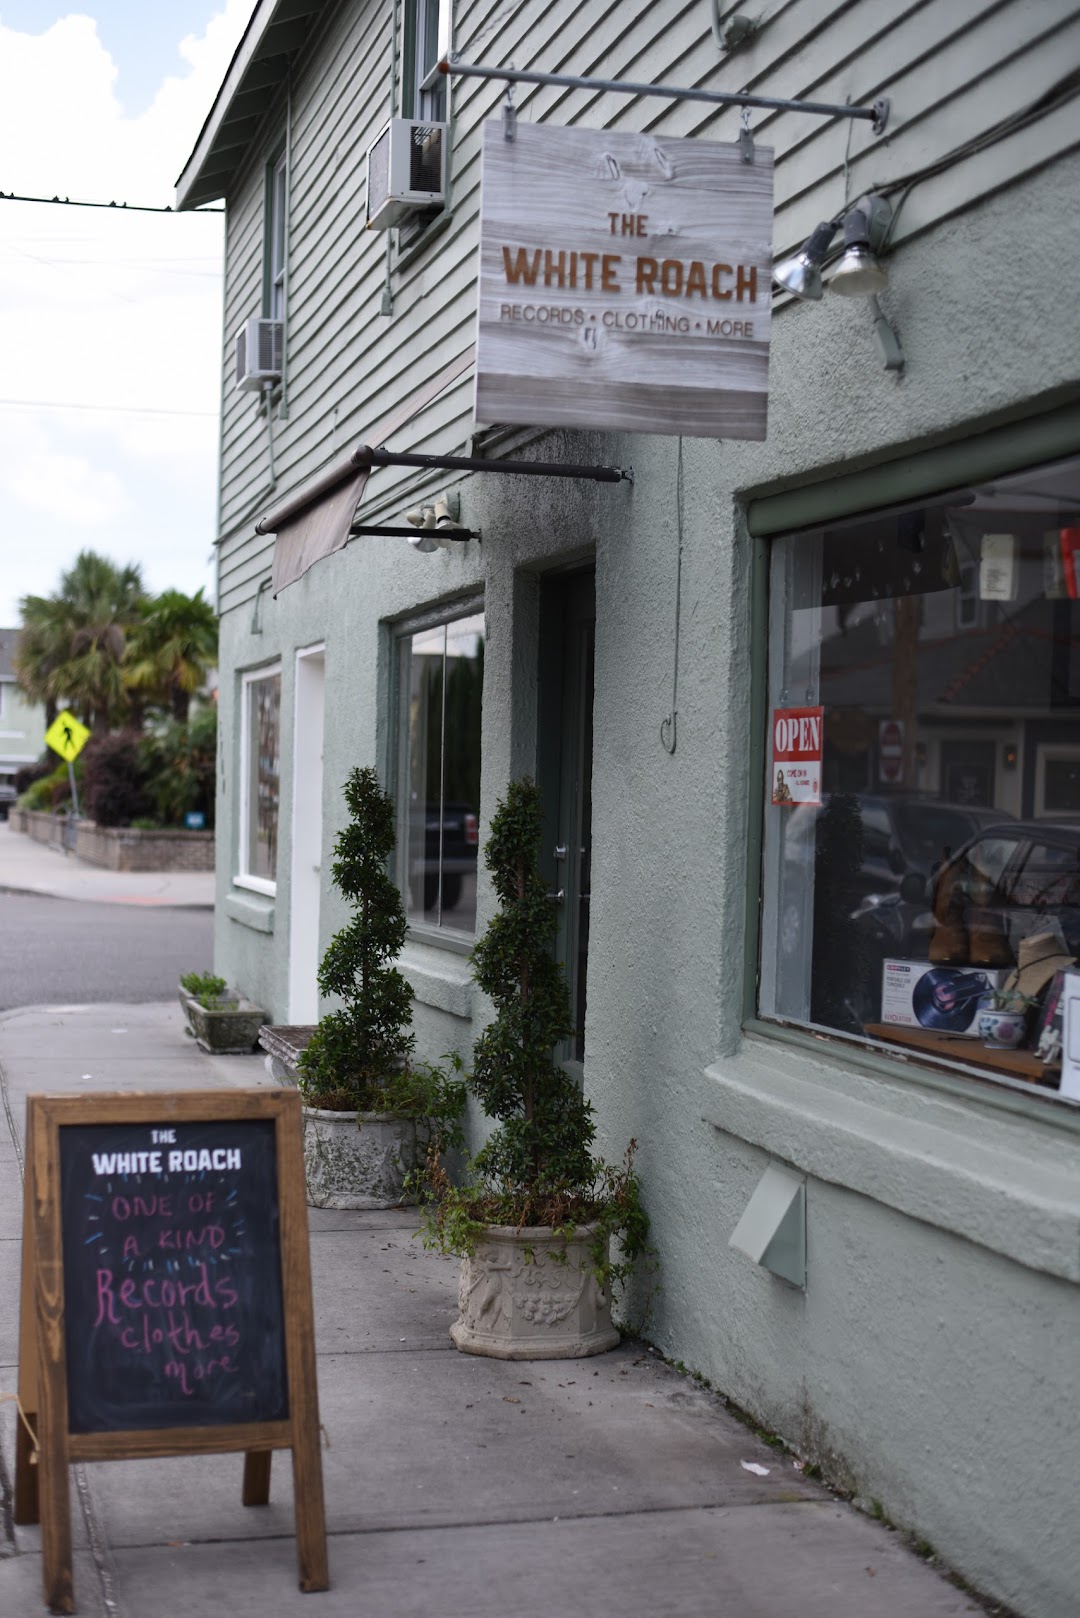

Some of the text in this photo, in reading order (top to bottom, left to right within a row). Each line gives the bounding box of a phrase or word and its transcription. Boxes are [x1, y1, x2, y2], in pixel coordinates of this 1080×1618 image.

[607, 212, 649, 238] THE
[501, 246, 758, 303] WHITE ROACH
[500, 304, 754, 338] RECORDS CLOTHING MORE
[775, 716, 821, 752] OPEN
[151, 1129, 177, 1144] THE
[92, 1148, 242, 1175] WHITE ROACH
[111, 1192, 214, 1221] ONE OF
[123, 1225, 225, 1257] A KIND
[94, 1262, 238, 1327] Records
[121, 1311, 240, 1354] clothes
[164, 1355, 238, 1395] more
